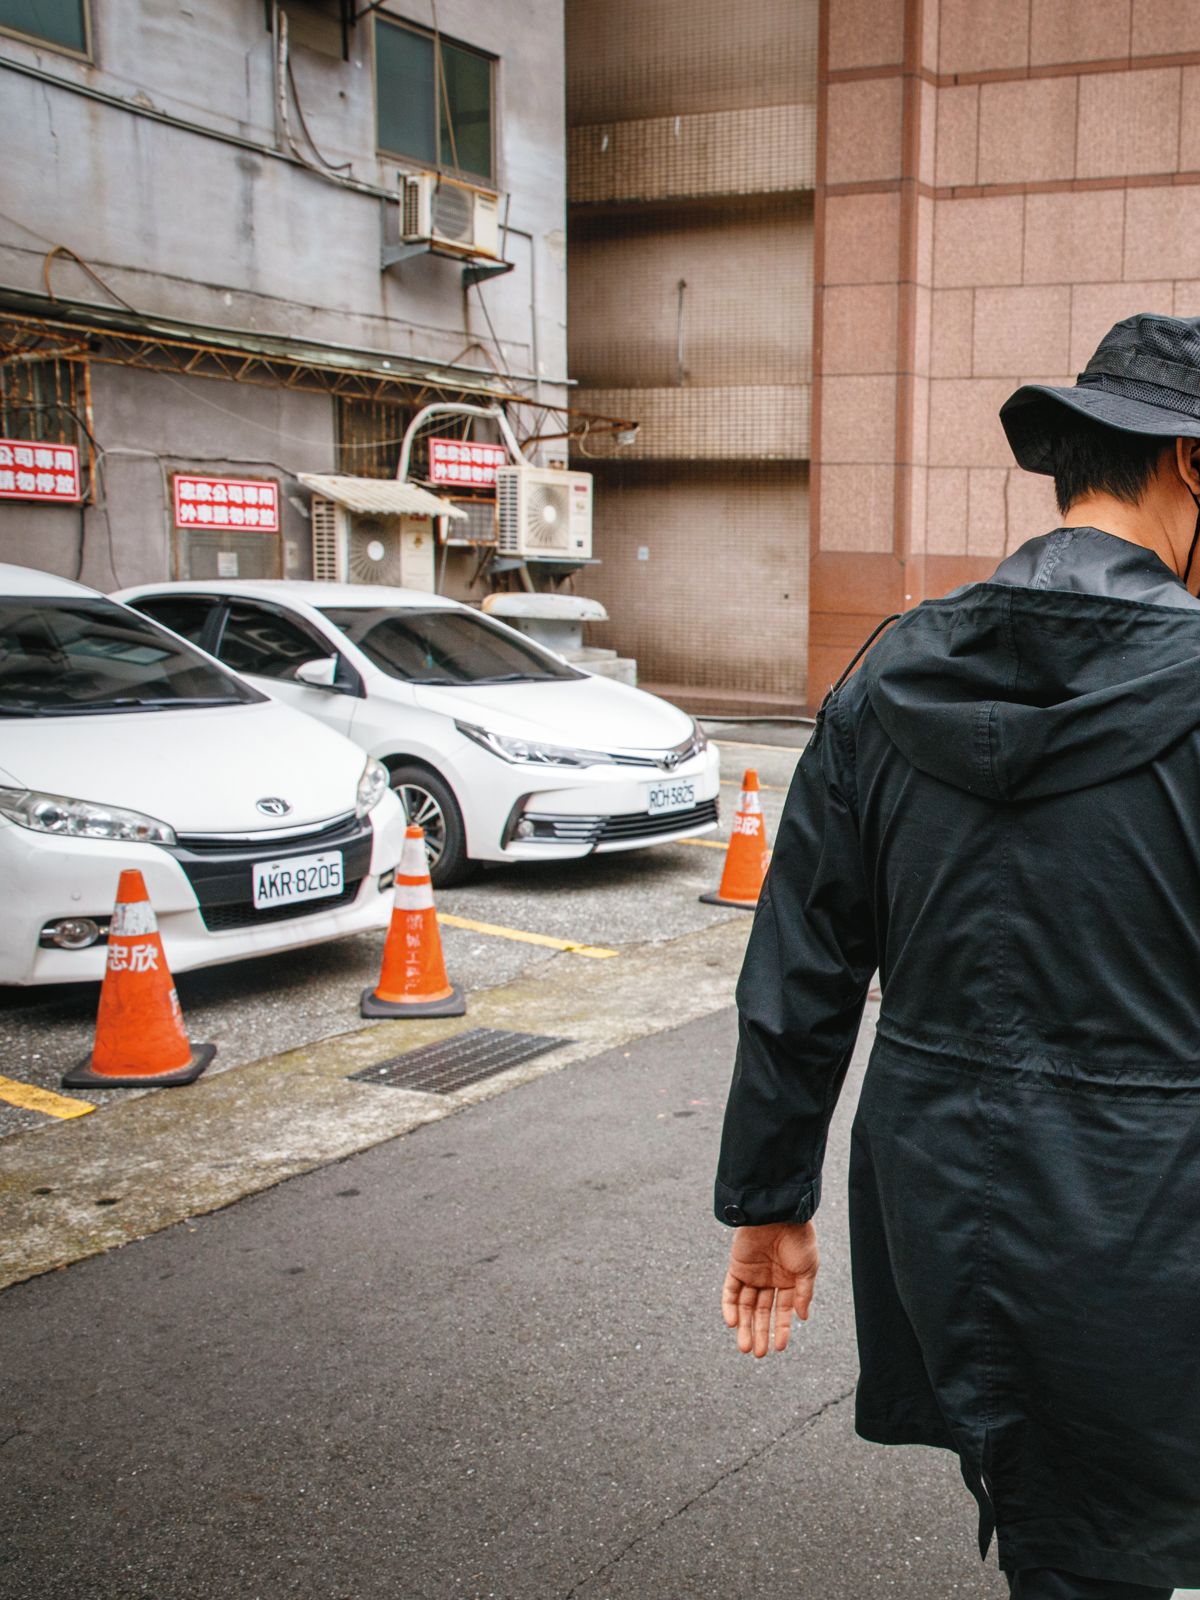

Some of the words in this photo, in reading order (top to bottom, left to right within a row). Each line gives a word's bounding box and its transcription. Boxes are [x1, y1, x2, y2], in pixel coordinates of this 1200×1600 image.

[435, 462, 497, 482] 外車請勿停
[180, 482, 274, 505] 忠欣公司專用
[181, 503, 275, 526] 外車請勿停放
